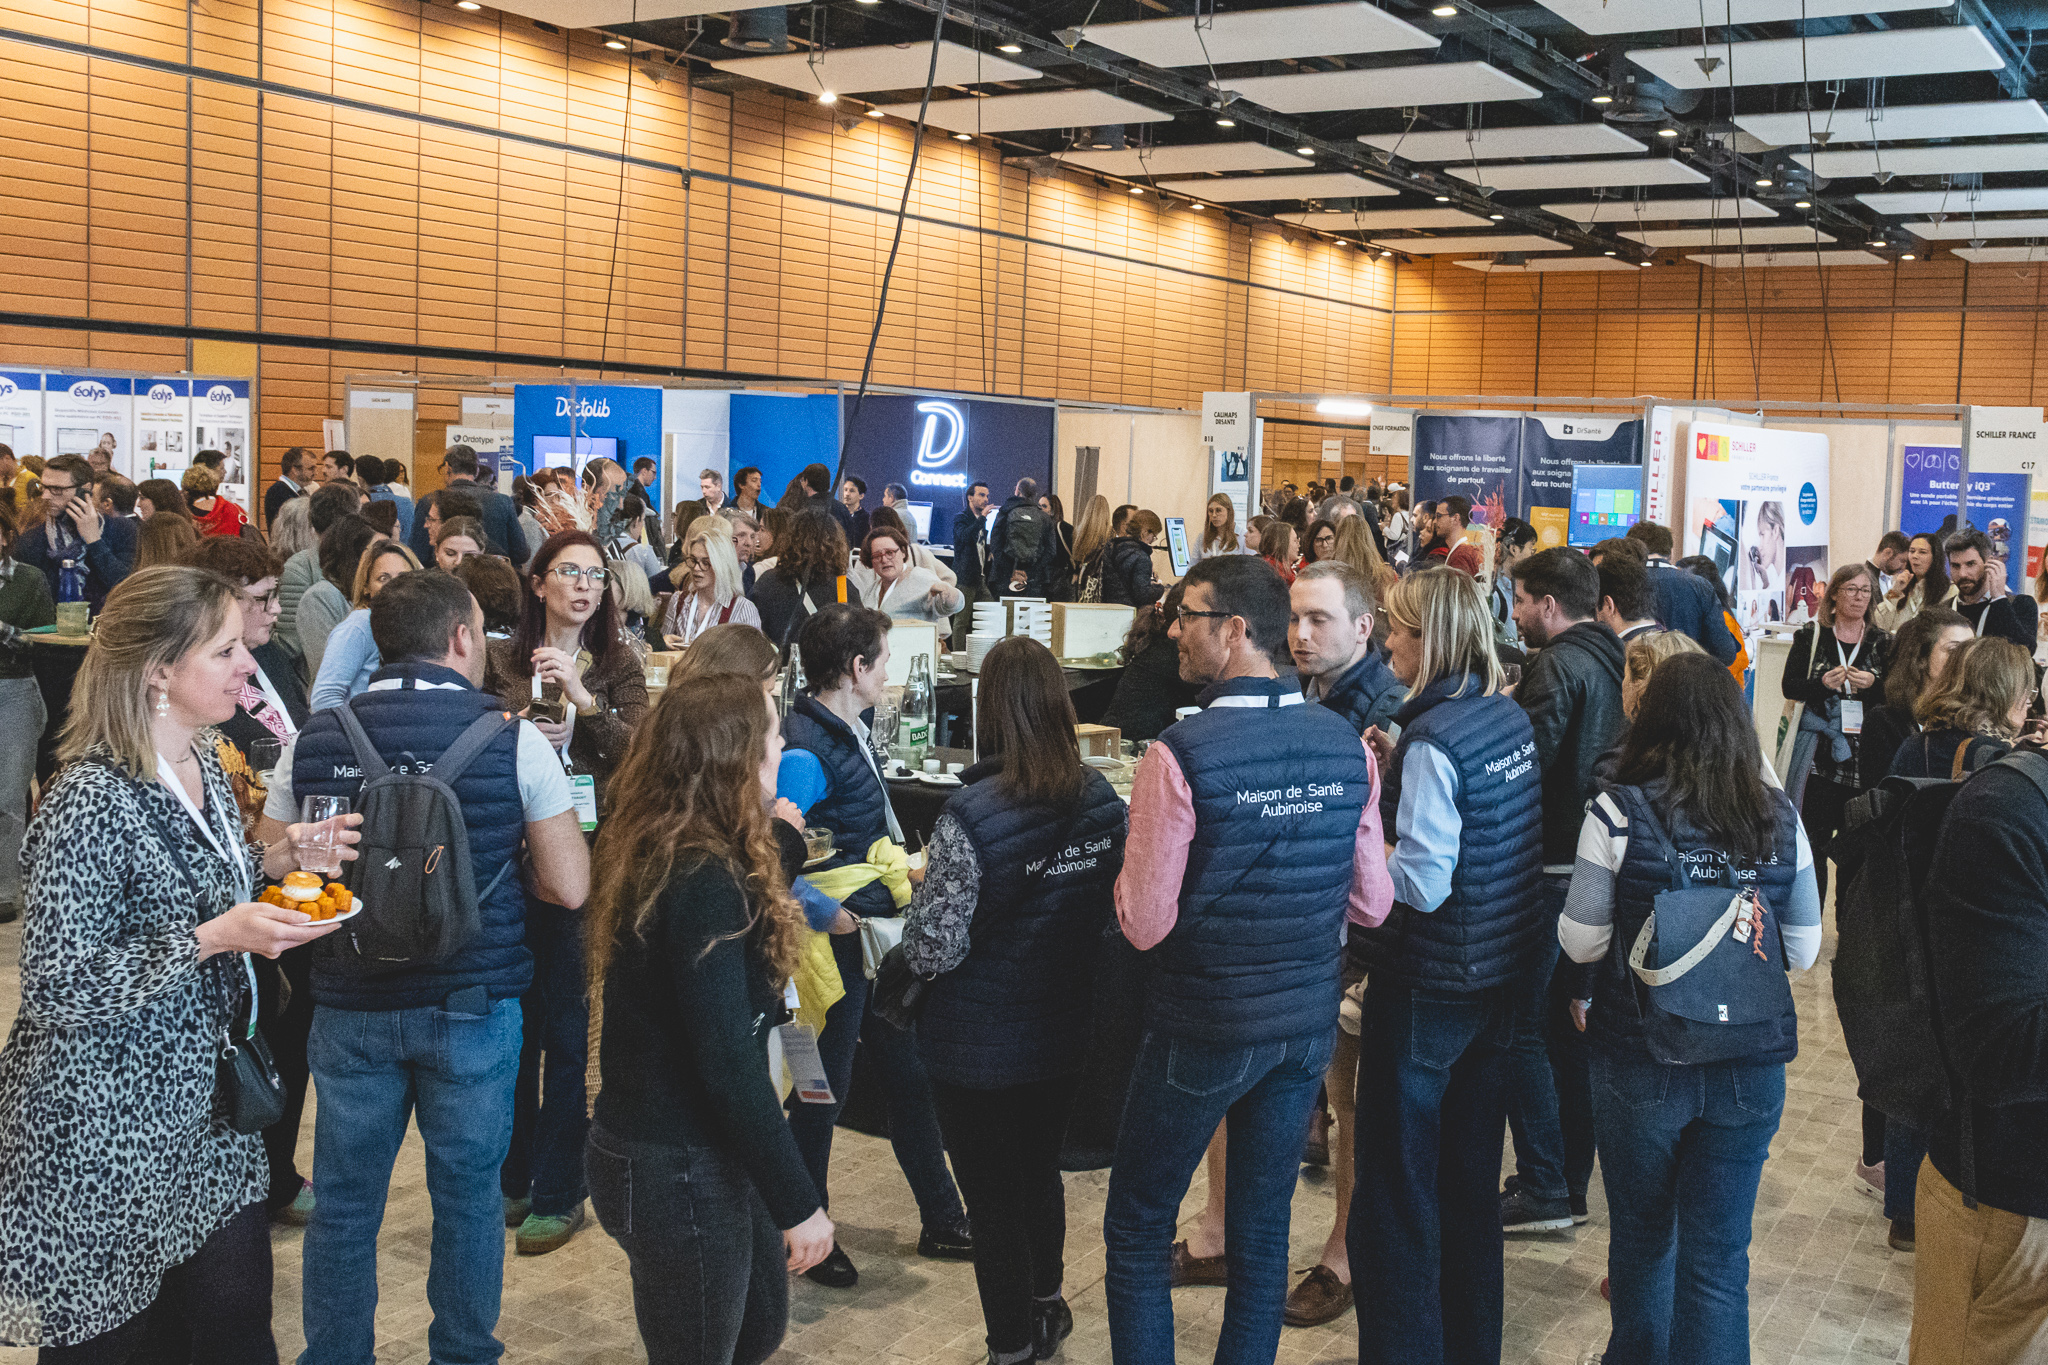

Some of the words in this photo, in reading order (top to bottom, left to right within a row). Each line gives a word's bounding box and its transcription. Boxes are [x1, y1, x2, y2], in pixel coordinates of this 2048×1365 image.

[0, 384, 13, 397] ys
[73, 385, 106, 401] éolys
[151, 388, 172, 404] éolys
[210, 390, 232, 405] éolys
[555, 396, 611, 418] Doctolib
[917, 402, 965, 468] D
[1576, 427, 1602, 435] DrSanté
[1976, 430, 2007, 439] SCHILLER
[2008, 431, 2037, 439] FRANCE
[462, 435, 495, 445] Ordotype
[1731, 440, 1756, 453] SCHILLER
[1429, 453, 1448, 461] Nous
[1448, 453, 1474, 462] offrons
[1474, 454, 1482, 462] la
[1482, 454, 1506, 463] liberté
[1540, 456, 1560, 466] Nous
[1436, 464, 1470, 474] soignants
[1470, 465, 1481, 473] de
[1481, 466, 1513, 474] travailler
[2021, 461, 2036, 470] C17
[910, 469, 967, 488] Connect
[1446, 475, 1457, 483] de
[1457, 476, 1486, 485] partout.
[1546, 469, 1572, 478] soigna
[1649, 430, 1662, 520] HILLER
[1531, 479, 1549, 487] dans
[1929, 480, 1973, 491] Buttery
[911, 730, 928, 741] BAD
[1484, 755, 1513, 776] Maison
[1512, 750, 1522, 762] de
[1504, 759, 1533, 783] Aubinoise
[1236, 789, 1281, 805] Maison
[1286, 785, 1303, 799] de
[1307, 781, 1344, 797] Santé
[1260, 800, 1324, 818] Aubinoise
[1064, 844, 1081, 858] de
[1084, 835, 1112, 854] Santé
[1043, 857, 1097, 879] Aubinoise
[1690, 864, 1757, 880] Aubiise
